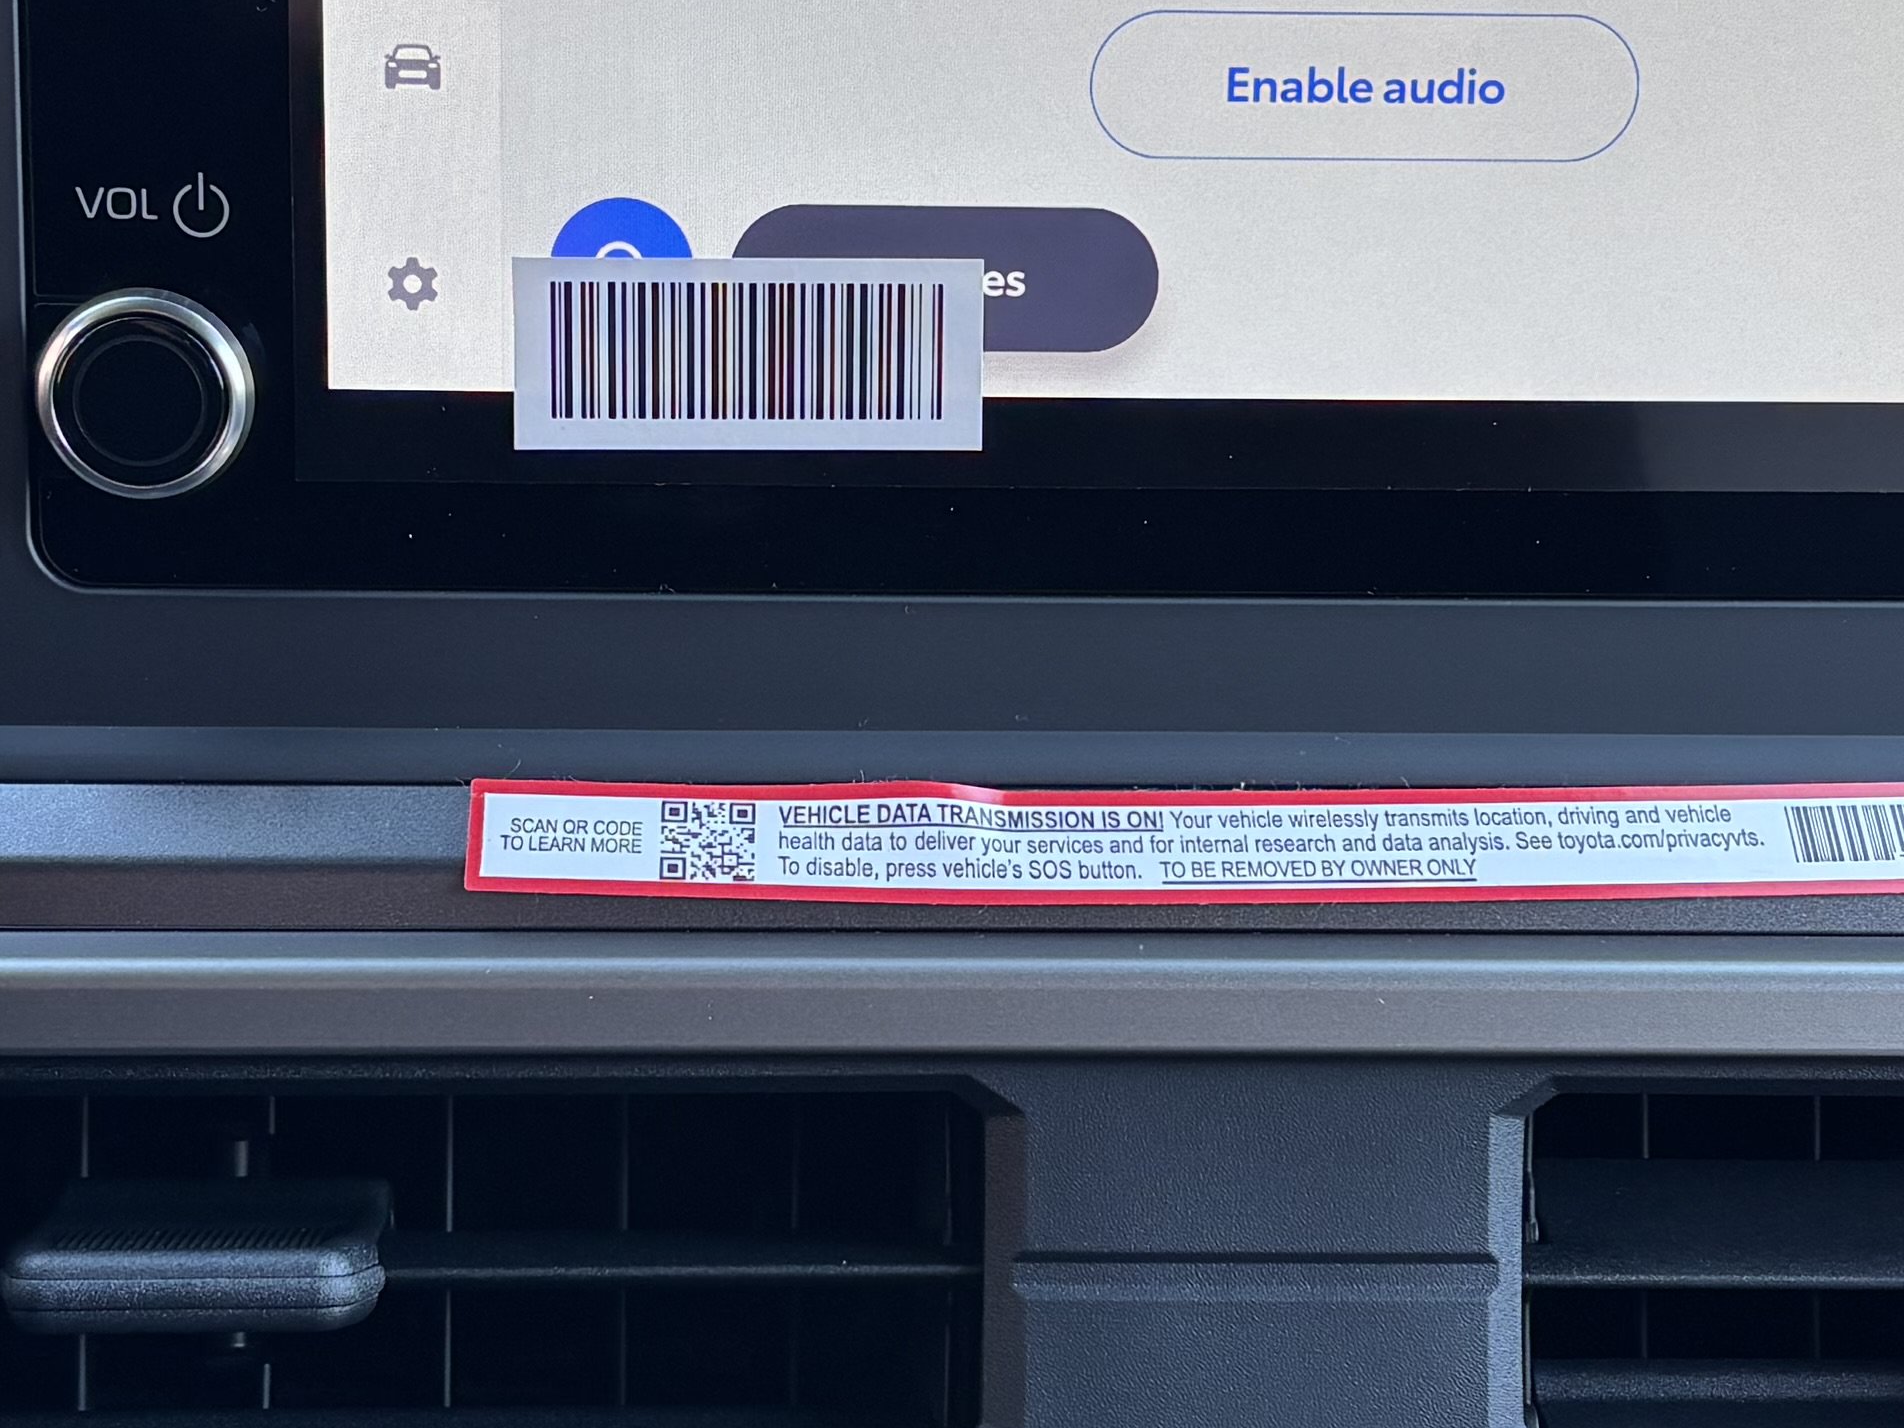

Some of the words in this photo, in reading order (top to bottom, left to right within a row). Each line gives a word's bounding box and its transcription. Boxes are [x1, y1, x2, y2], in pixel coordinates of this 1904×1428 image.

[1226, 66, 1374, 104] Enable
[1383, 67, 1506, 106] audio
[75, 186, 158, 220] VOL
[510, 818, 558, 834] SCAN
[563, 819, 588, 835] QR
[593, 820, 643, 836] CODE
[779, 804, 871, 824] VEHICLE
[877, 803, 931, 823] DATA
[937, 804, 1095, 829] TRANSMISSION
[1102, 811, 1120, 828] IS
[1127, 811, 1164, 829] ON!
[1170, 811, 1212, 829] Your
[1218, 810, 1283, 829] vehicle
[1288, 808, 1379, 832] wirelessly
[1384, 809, 1469, 827] transmits
[1474, 807, 1553, 828] location,
[1558, 806, 1620, 829] driving
[1626, 806, 1661, 824] and
[1665, 805, 1732, 823] vehicle
[500, 835, 524, 851] TO
[529, 835, 585, 852] LEARN
[591, 837, 642, 854] MORE
[778, 831, 836, 851] health
[841, 831, 883, 852] data
[889, 833, 907, 852] to
[914, 830, 976, 852] deliver
[981, 837, 1022, 856] your
[1027, 836, 1104, 854] services
[1109, 835, 1144, 854] and
[1150, 834, 1174, 854] for
[1179, 834, 1249, 854] internal
[1255, 834, 1336, 853] research
[1342, 834, 1376, 852] and
[1382, 833, 1423, 852] data
[1429, 832, 1511, 855] analysis.
[1516, 831, 1553, 850] See
[1557, 828, 1765, 854] toyota.com/privacyvts.
[778, 856, 800, 875] To
[806, 856, 879, 880] disable,
[886, 862, 937, 881] press
[1028, 860, 1072, 879] SOS
[1078, 860, 1143, 879] button.
[1159, 861, 1186, 878] TO
[1191, 861, 1216, 878] BE
[1222, 860, 1316, 878] REMOVED
[1322, 860, 1346, 877] BY
[1351, 859, 1423, 877] OWNER
[1427, 858, 1476, 875] ONLY
